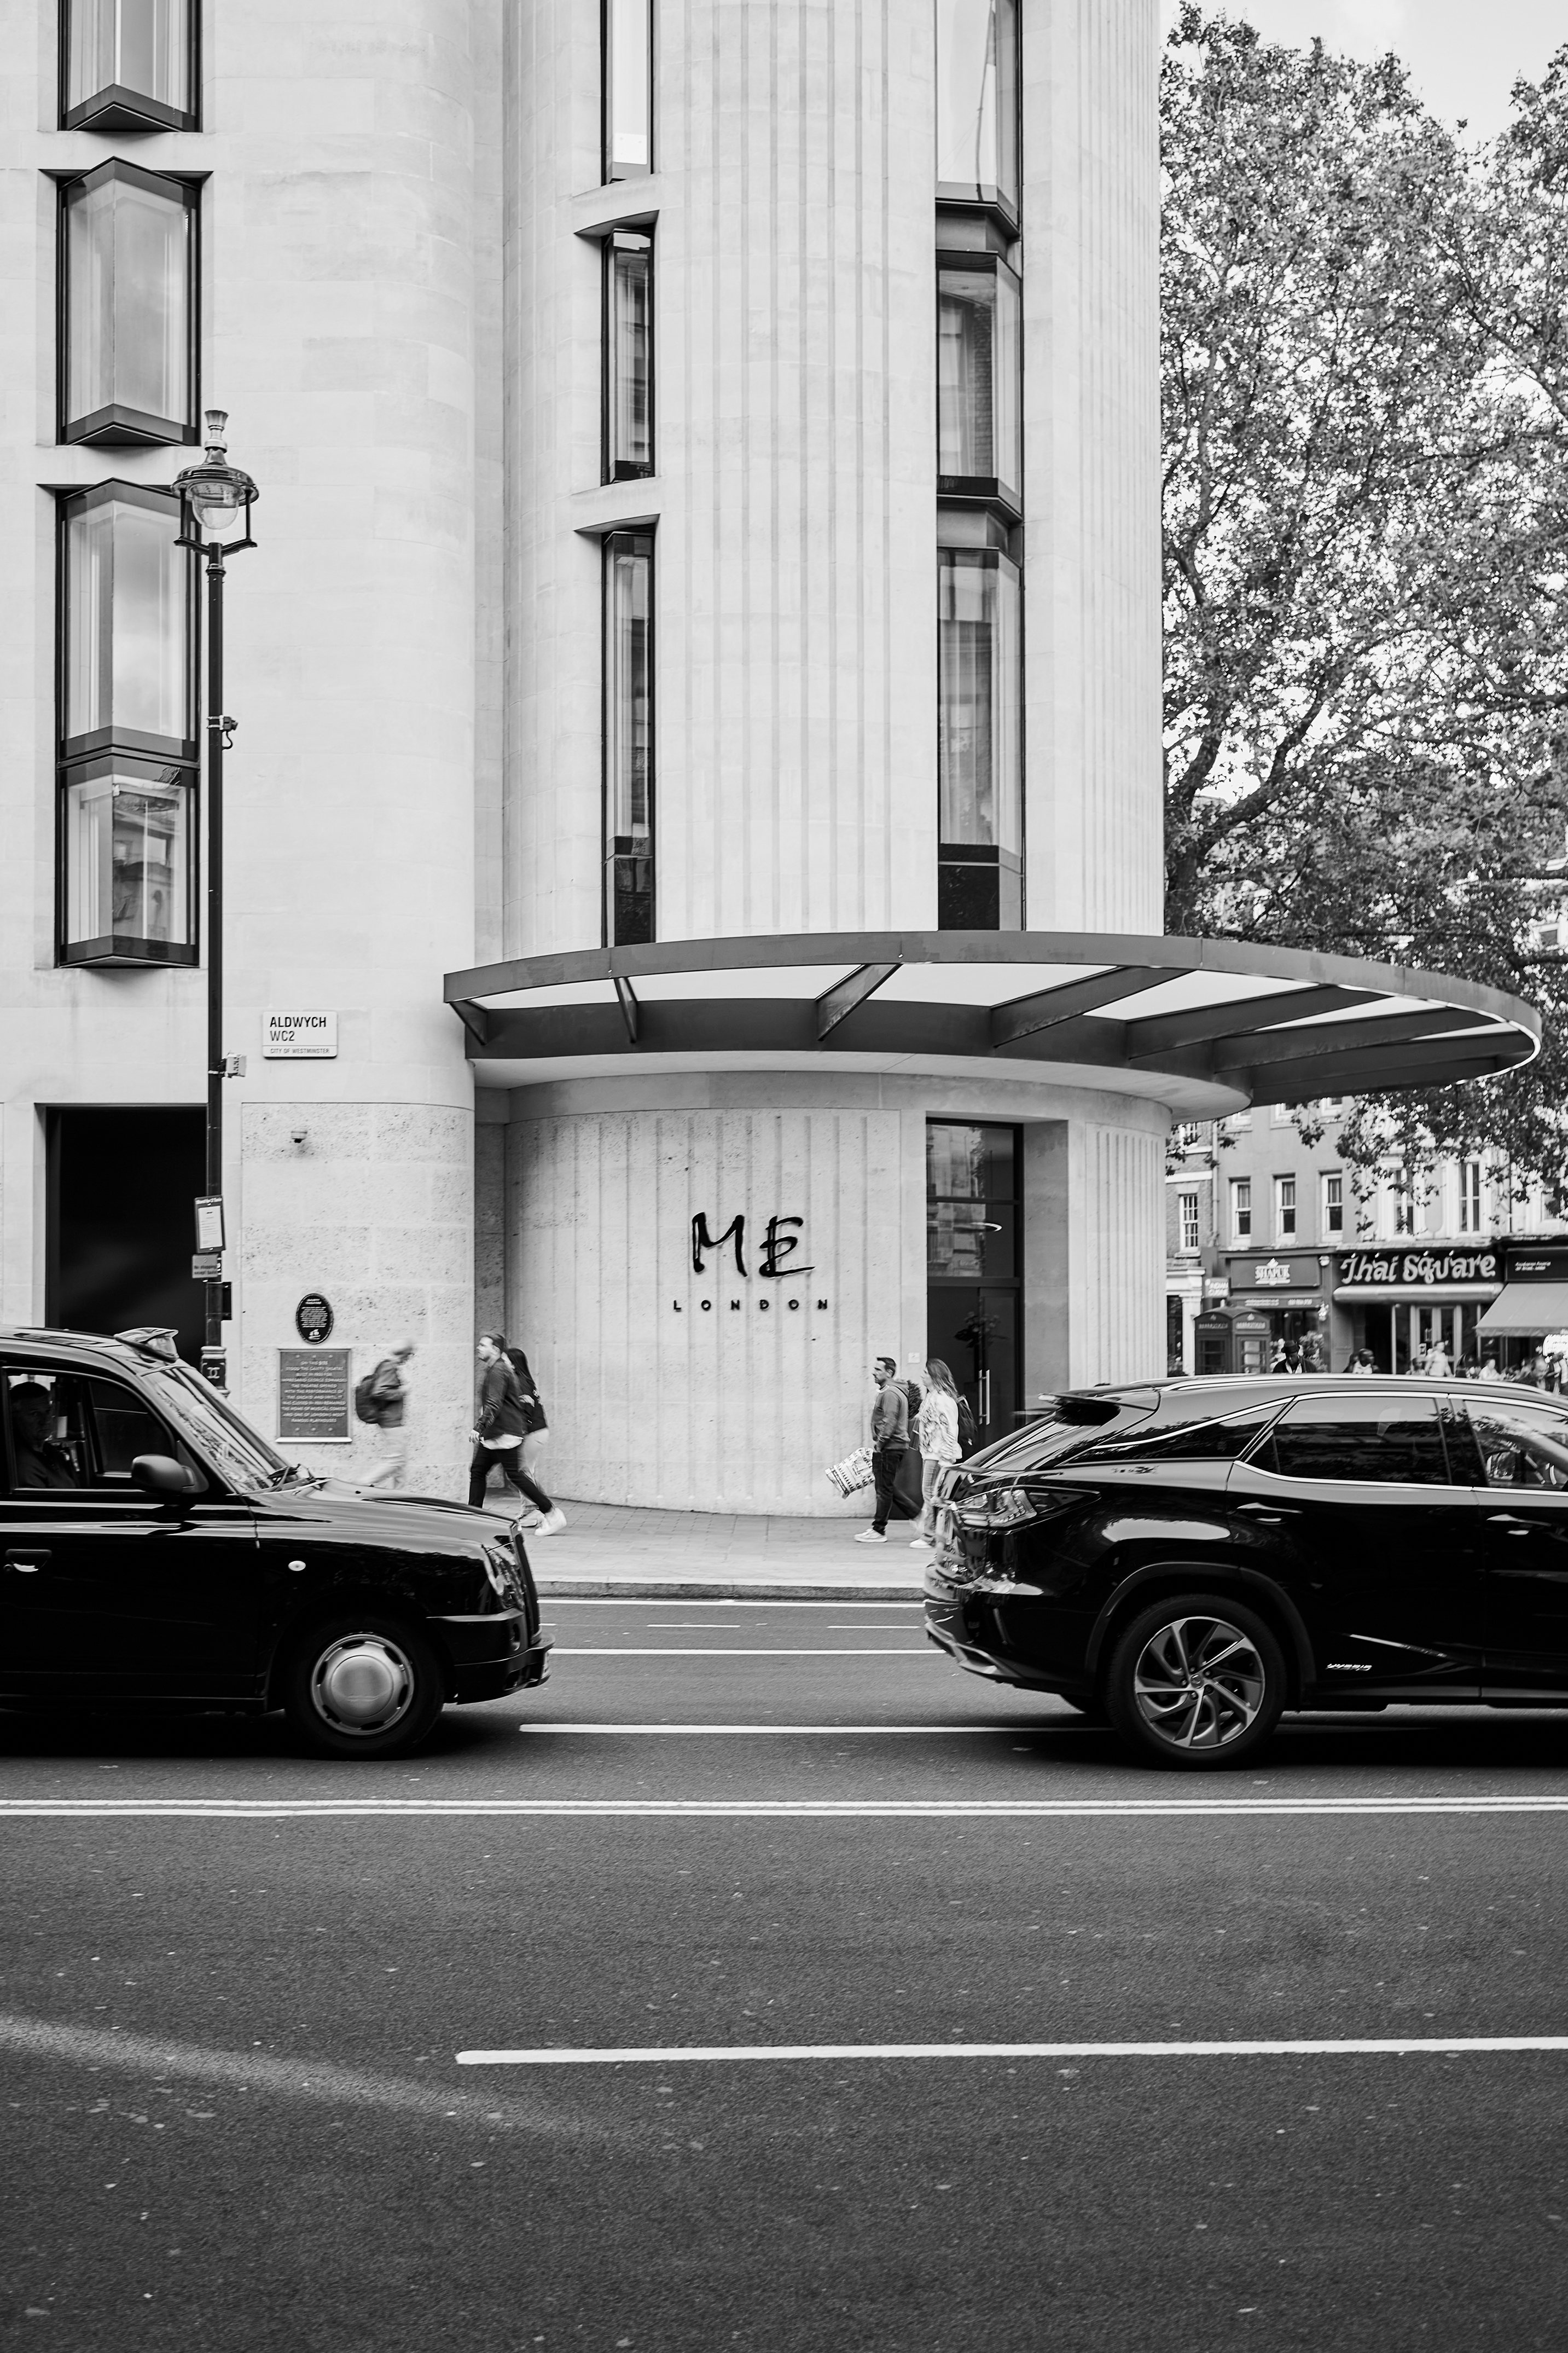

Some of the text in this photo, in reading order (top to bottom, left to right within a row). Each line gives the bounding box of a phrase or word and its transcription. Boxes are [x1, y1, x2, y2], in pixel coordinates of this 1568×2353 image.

[270, 1016, 327, 1028] ALDWYCH
[270, 1030, 295, 1041] WC2
[691, 1212, 815, 1278] ME
[1340, 1254, 1496, 1284] Thai Square
[673, 1299, 828, 1312] LONDON
